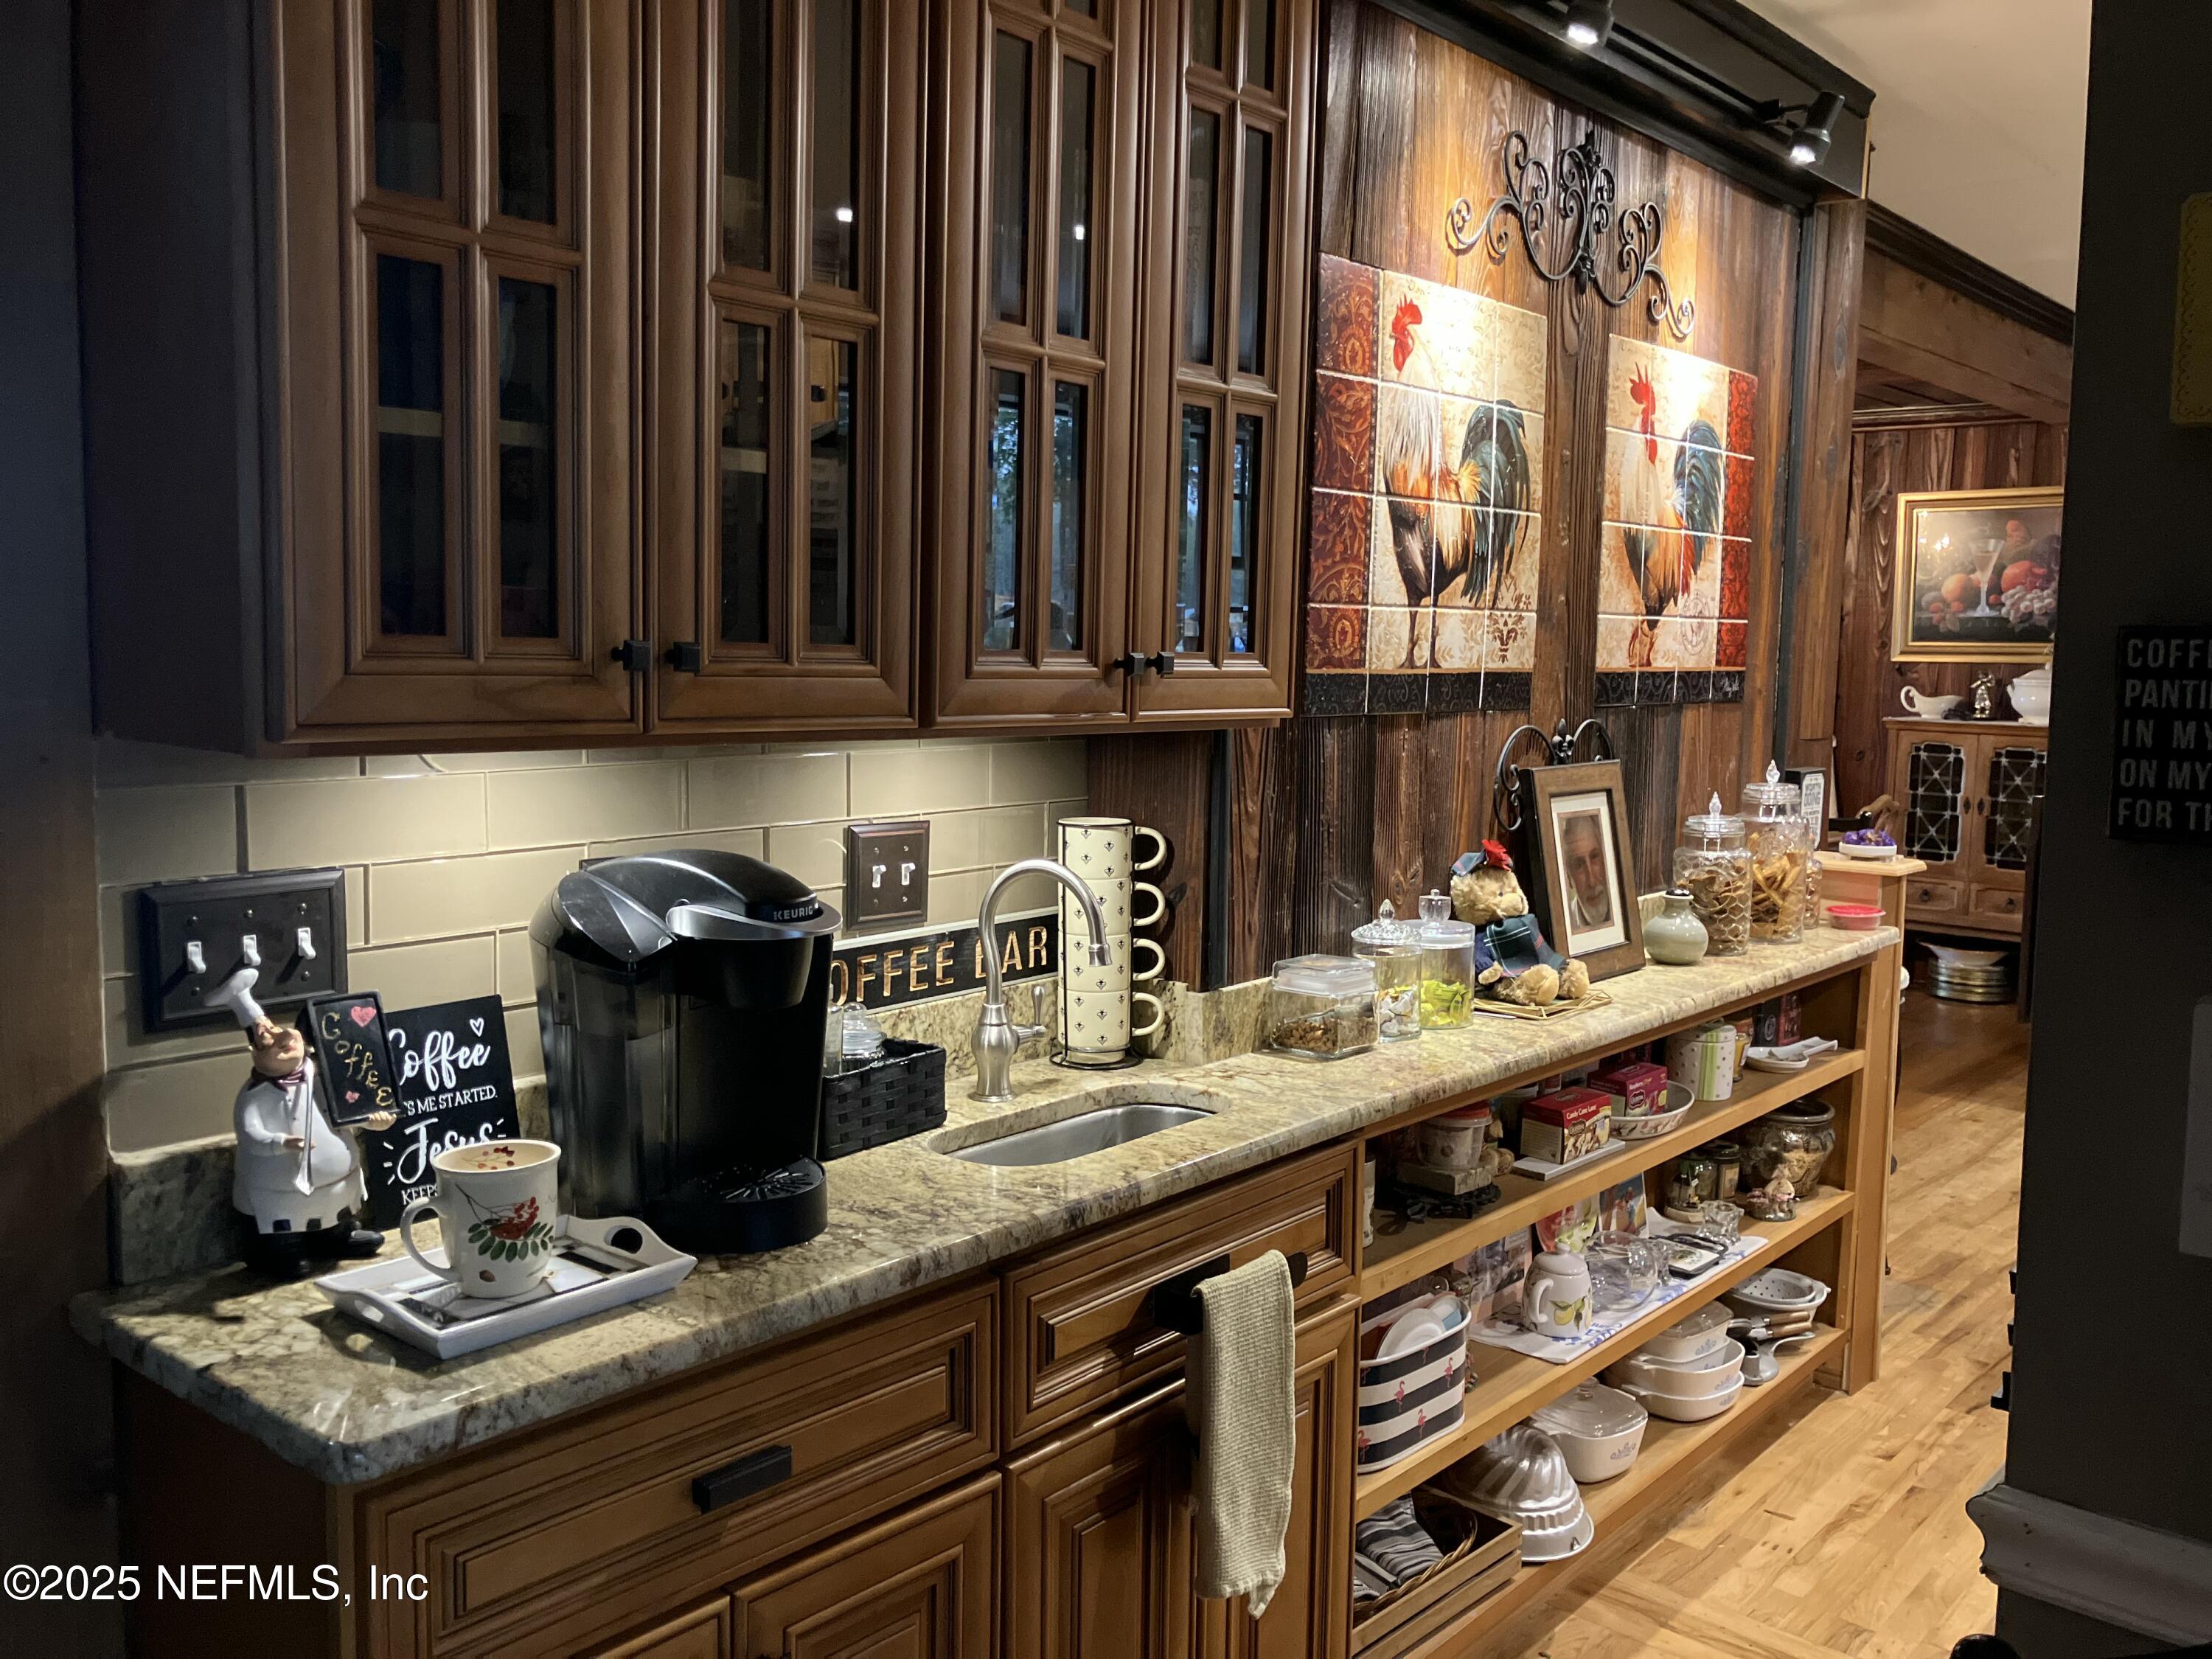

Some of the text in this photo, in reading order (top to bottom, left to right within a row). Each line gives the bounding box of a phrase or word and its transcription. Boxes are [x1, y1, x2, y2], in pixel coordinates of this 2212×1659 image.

[2125, 678, 2212, 709] PANTI
[2122, 719, 2154, 748] IN
[2120, 758, 2212, 790] ON MY
[2118, 797, 2172, 830] FOR
[773, 905, 813, 921] KEURIG
[829, 941, 955, 1006] OFFEE
[417, 1096, 438, 1114] ME
[439, 1085, 498, 1110] STARTED.
